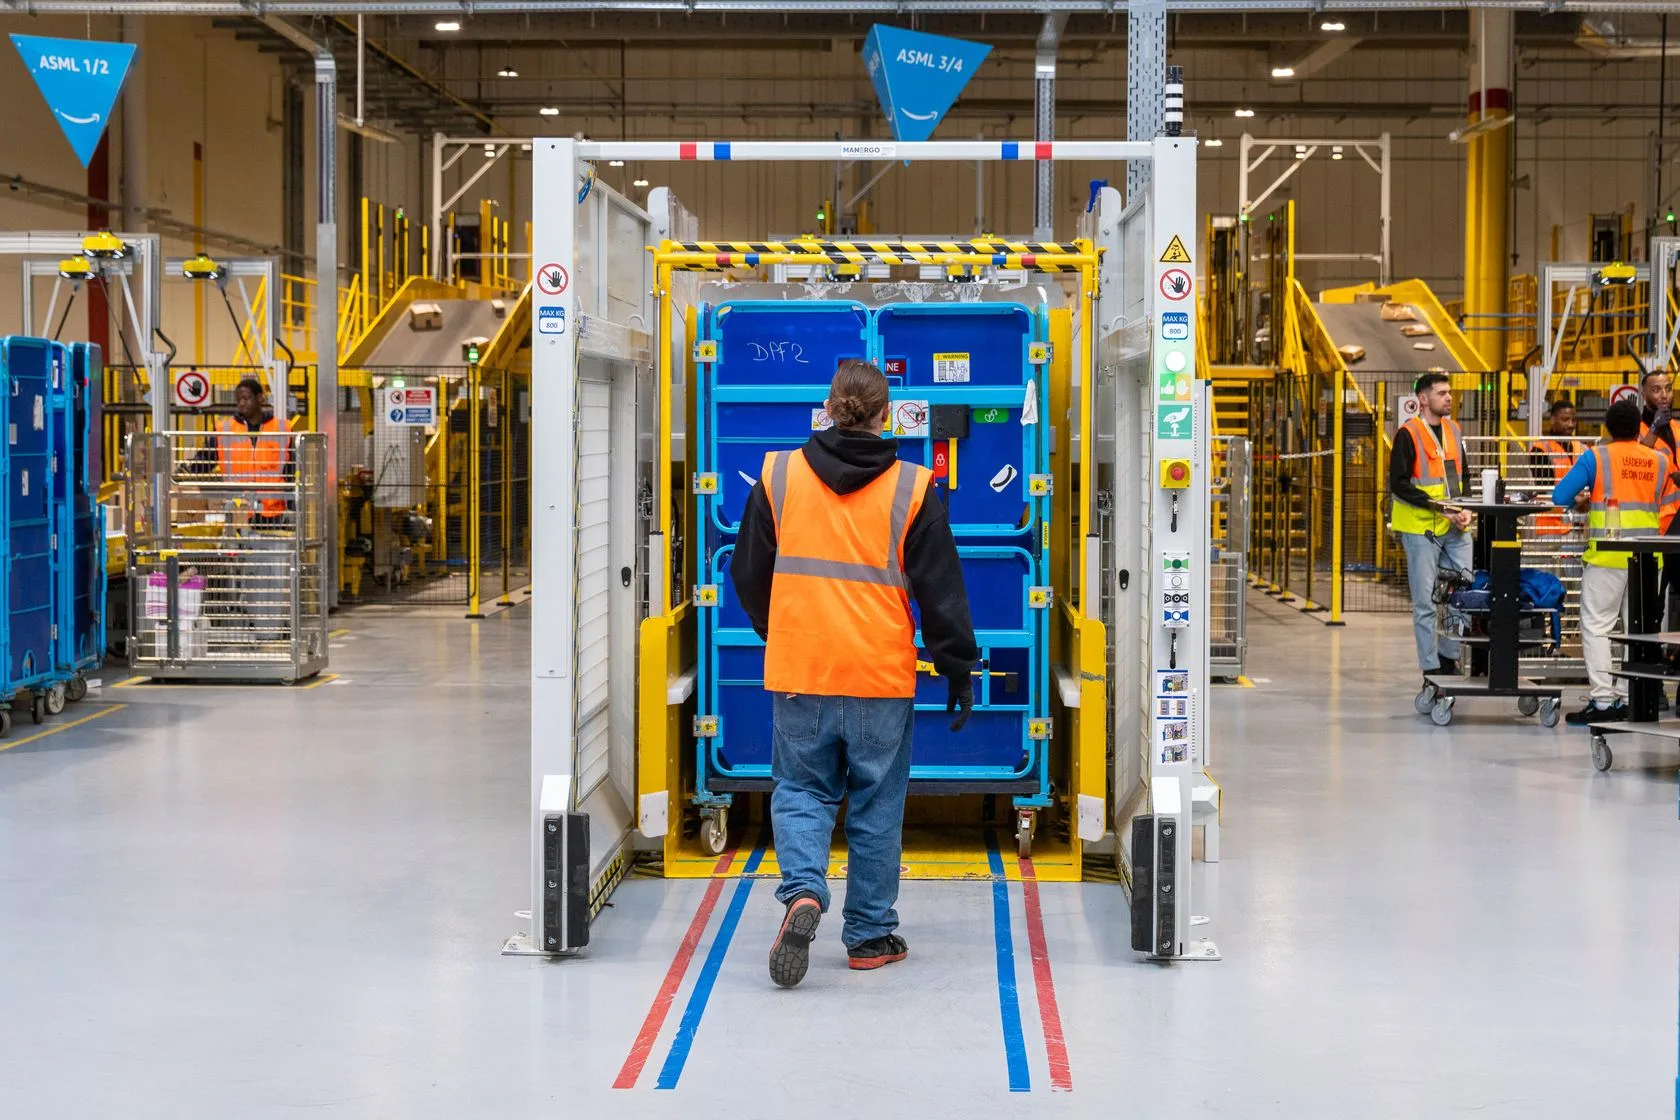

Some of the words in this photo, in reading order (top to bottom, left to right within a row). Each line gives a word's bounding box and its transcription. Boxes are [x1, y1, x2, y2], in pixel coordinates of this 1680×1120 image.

[40, 54, 80, 72] ASML
[83, 58, 109, 75] 1/2
[896, 48, 935, 68] ASML
[938, 55, 964, 73] 3/4
[1163, 315, 1178, 323] MAX
[1179, 315, 1188, 323] KG
[1622, 456, 1654, 468] LEADERSHIP
